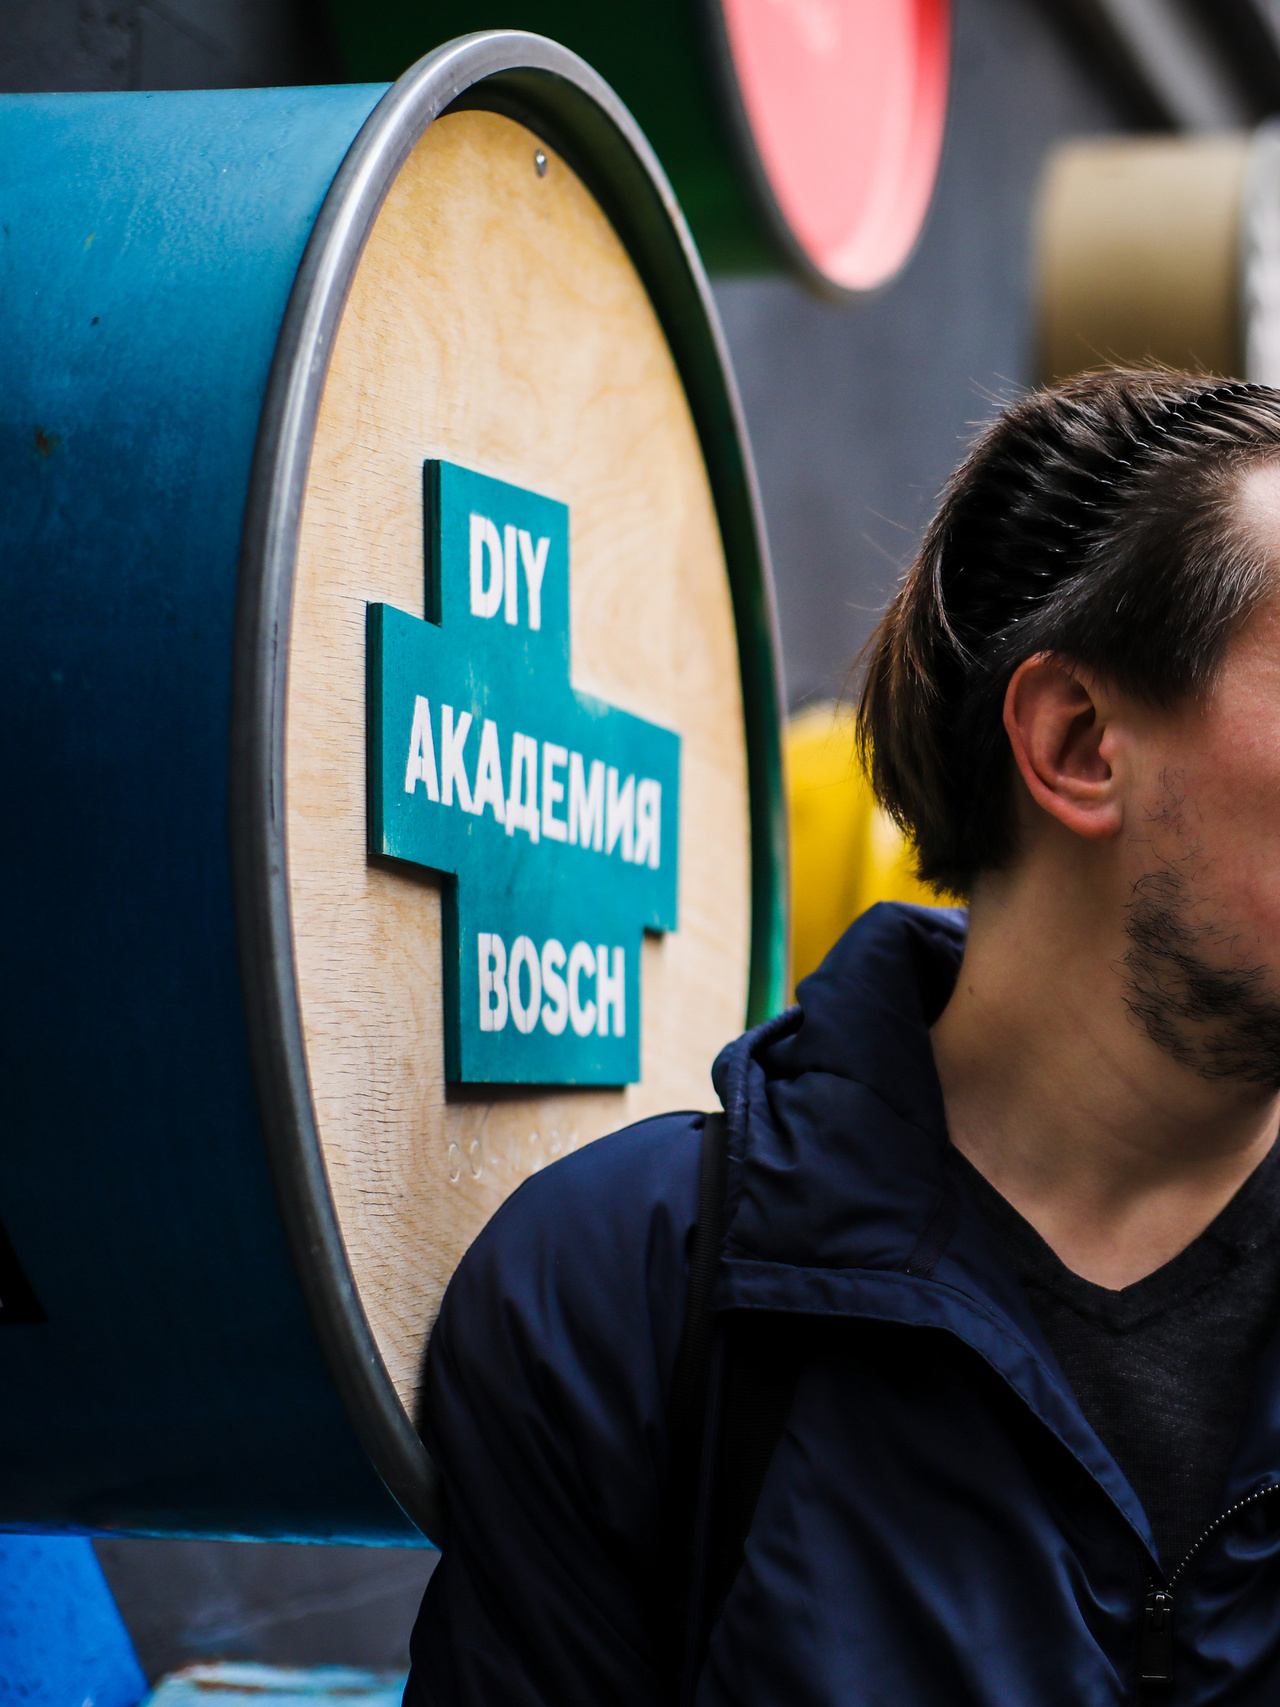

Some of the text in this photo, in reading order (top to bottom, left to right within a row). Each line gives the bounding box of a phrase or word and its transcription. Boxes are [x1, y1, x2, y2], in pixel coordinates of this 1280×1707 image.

[468, 513, 551, 631] DIY
[403, 695, 662, 870] АКАДЕМИЯ
[477, 932, 626, 1038] BOSCH
